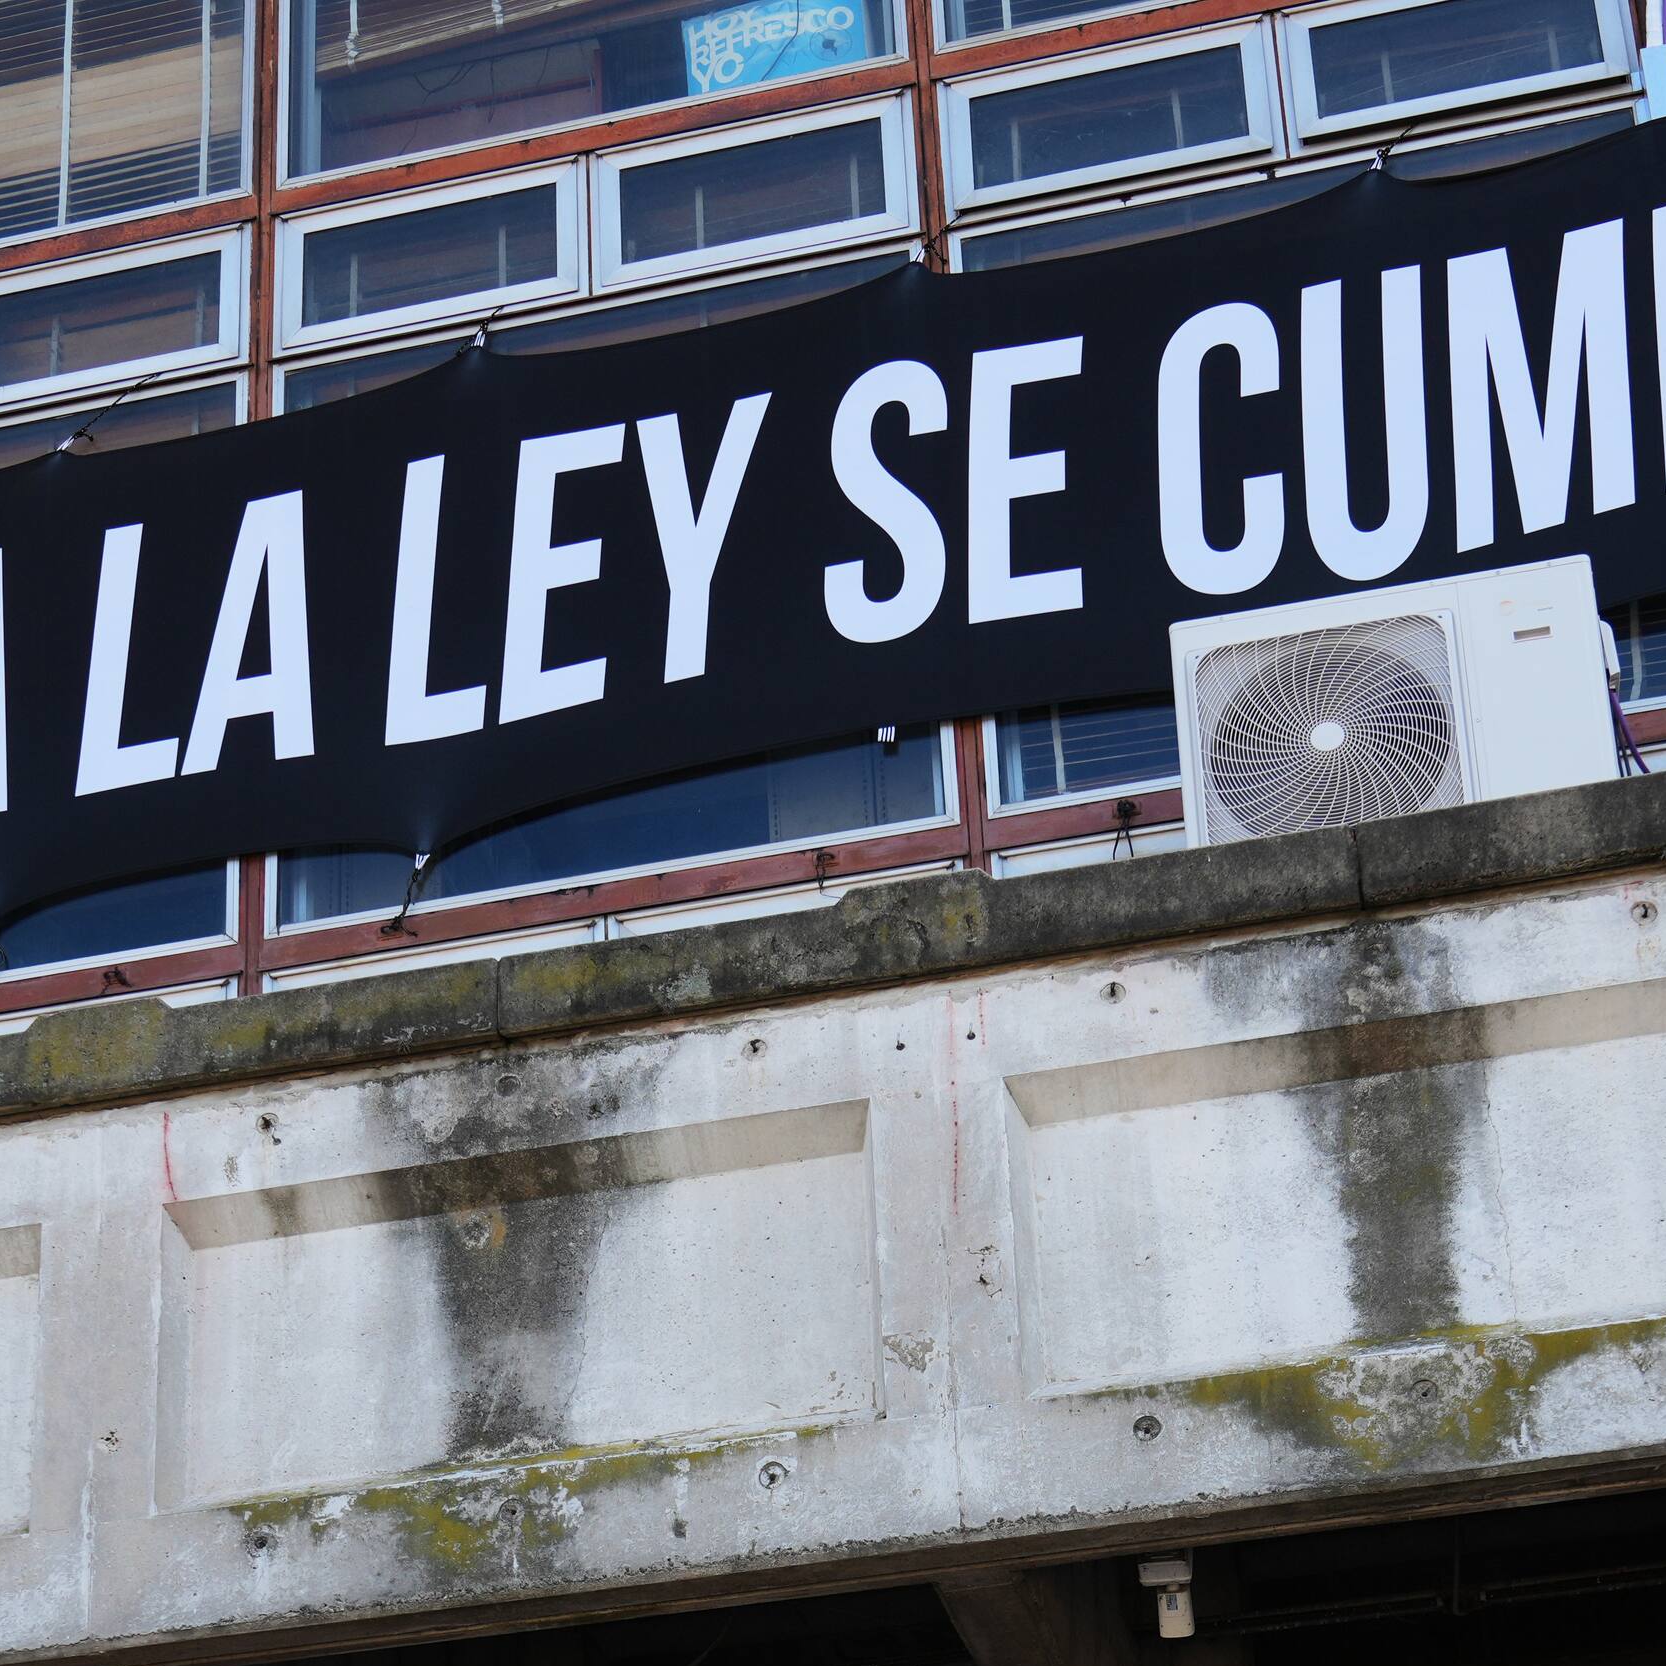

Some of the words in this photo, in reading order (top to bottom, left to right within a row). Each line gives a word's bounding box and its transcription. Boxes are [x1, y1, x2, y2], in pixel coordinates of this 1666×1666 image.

[690, 52, 744, 94] YO
[74, 490, 315, 797] LA
[384, 391, 773, 746] LEY
[824, 335, 1084, 645] SE
